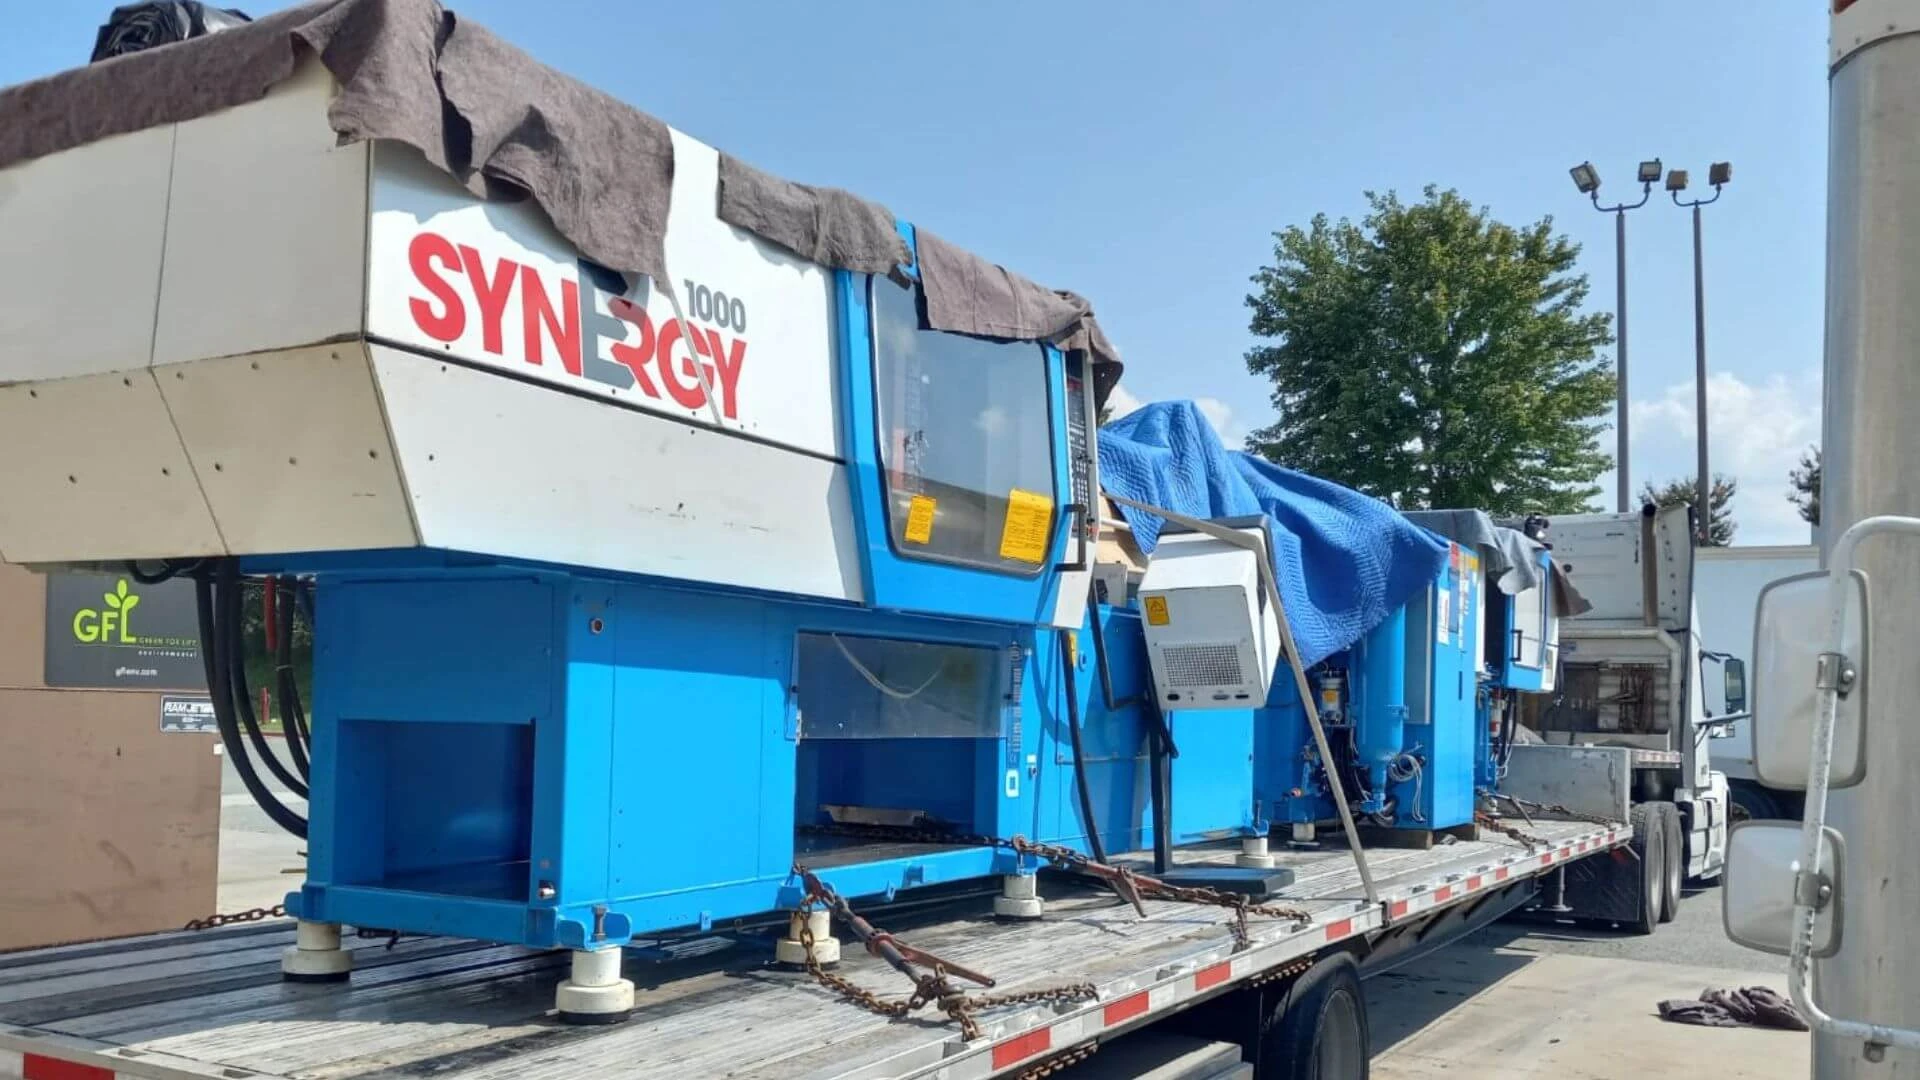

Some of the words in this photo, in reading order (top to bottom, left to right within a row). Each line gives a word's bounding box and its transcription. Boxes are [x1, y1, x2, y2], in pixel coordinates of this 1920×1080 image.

[408, 232, 747, 420] SYNERGY
[684, 279, 746, 333] 1000
[73, 597, 138, 642] GFL
